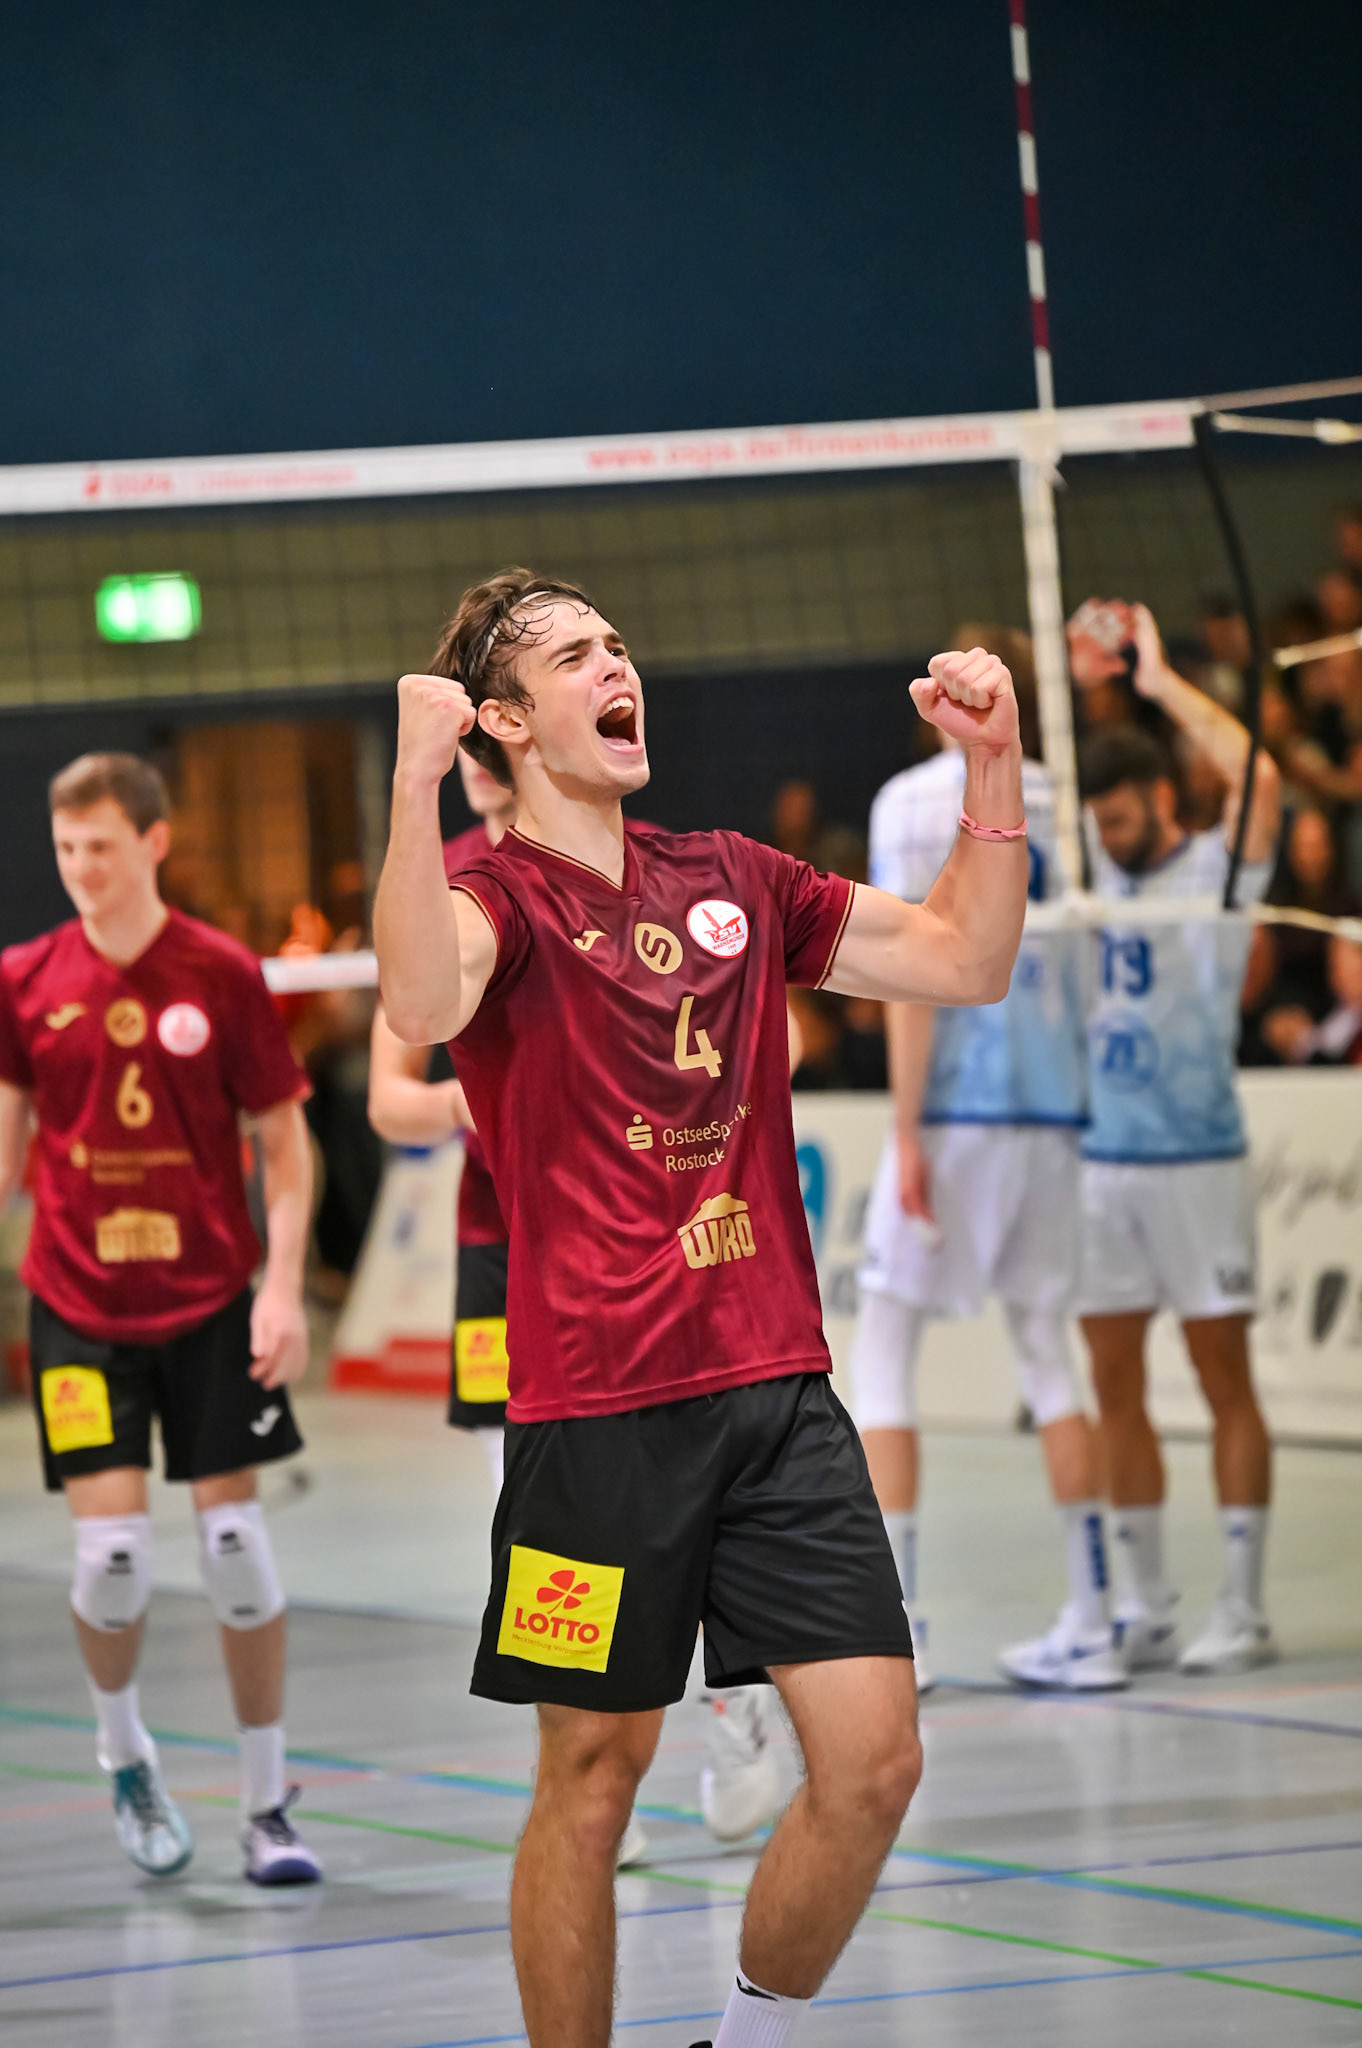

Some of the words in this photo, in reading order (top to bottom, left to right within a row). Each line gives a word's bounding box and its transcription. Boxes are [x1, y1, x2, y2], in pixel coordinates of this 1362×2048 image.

[673, 995, 723, 1078] 4
[116, 1060, 154, 1130] 6
[665, 1147, 726, 1173] Rostock
[514, 1607, 600, 1645] LOTTO
